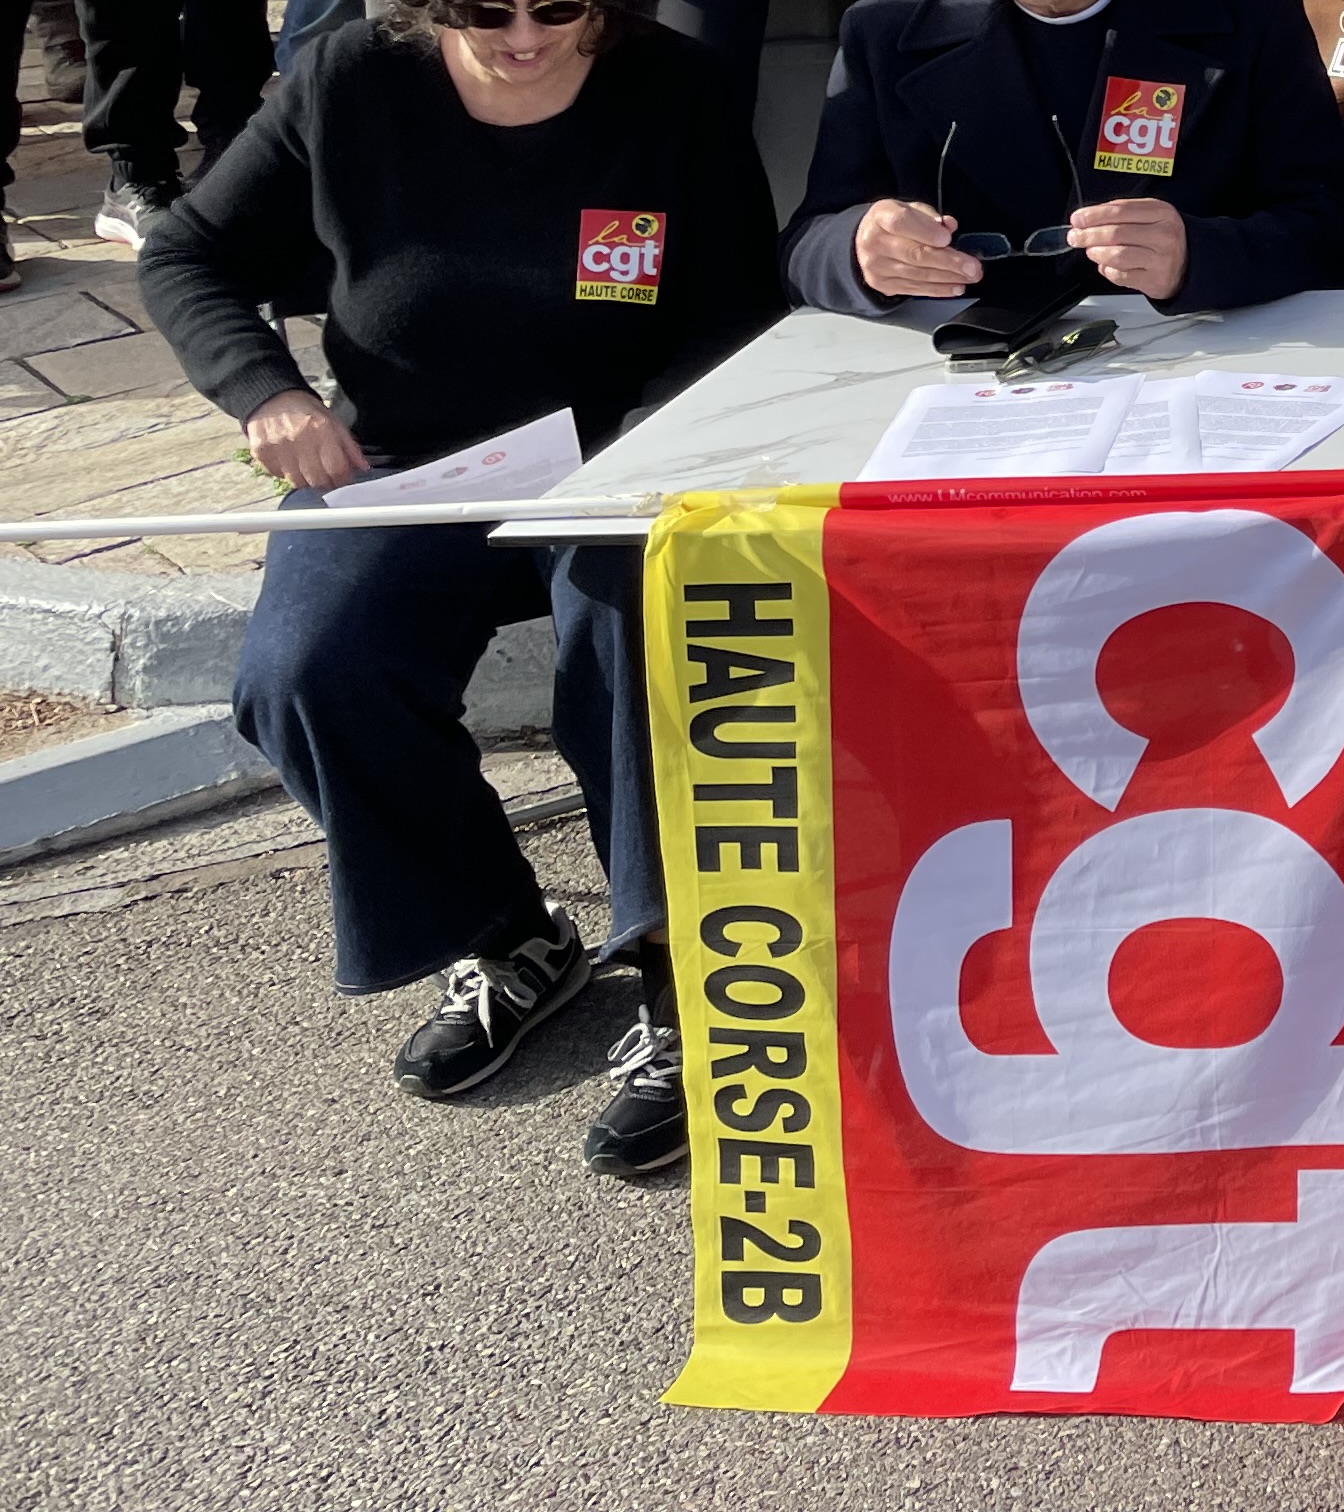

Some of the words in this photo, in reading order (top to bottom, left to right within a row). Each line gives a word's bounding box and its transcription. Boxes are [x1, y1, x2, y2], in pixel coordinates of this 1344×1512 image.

[1104, 113, 1176, 155] cgt
[1098, 154, 1133, 171] HAUTE
[1136, 158, 1170, 174] CORSE
[582, 240, 660, 282] cgt
[579, 284, 617, 299] HAUTE
[620, 287, 655, 302] CORSE
[683, 580, 800, 874] HAUTE
[698, 903, 823, 1326] CORSE-2B
